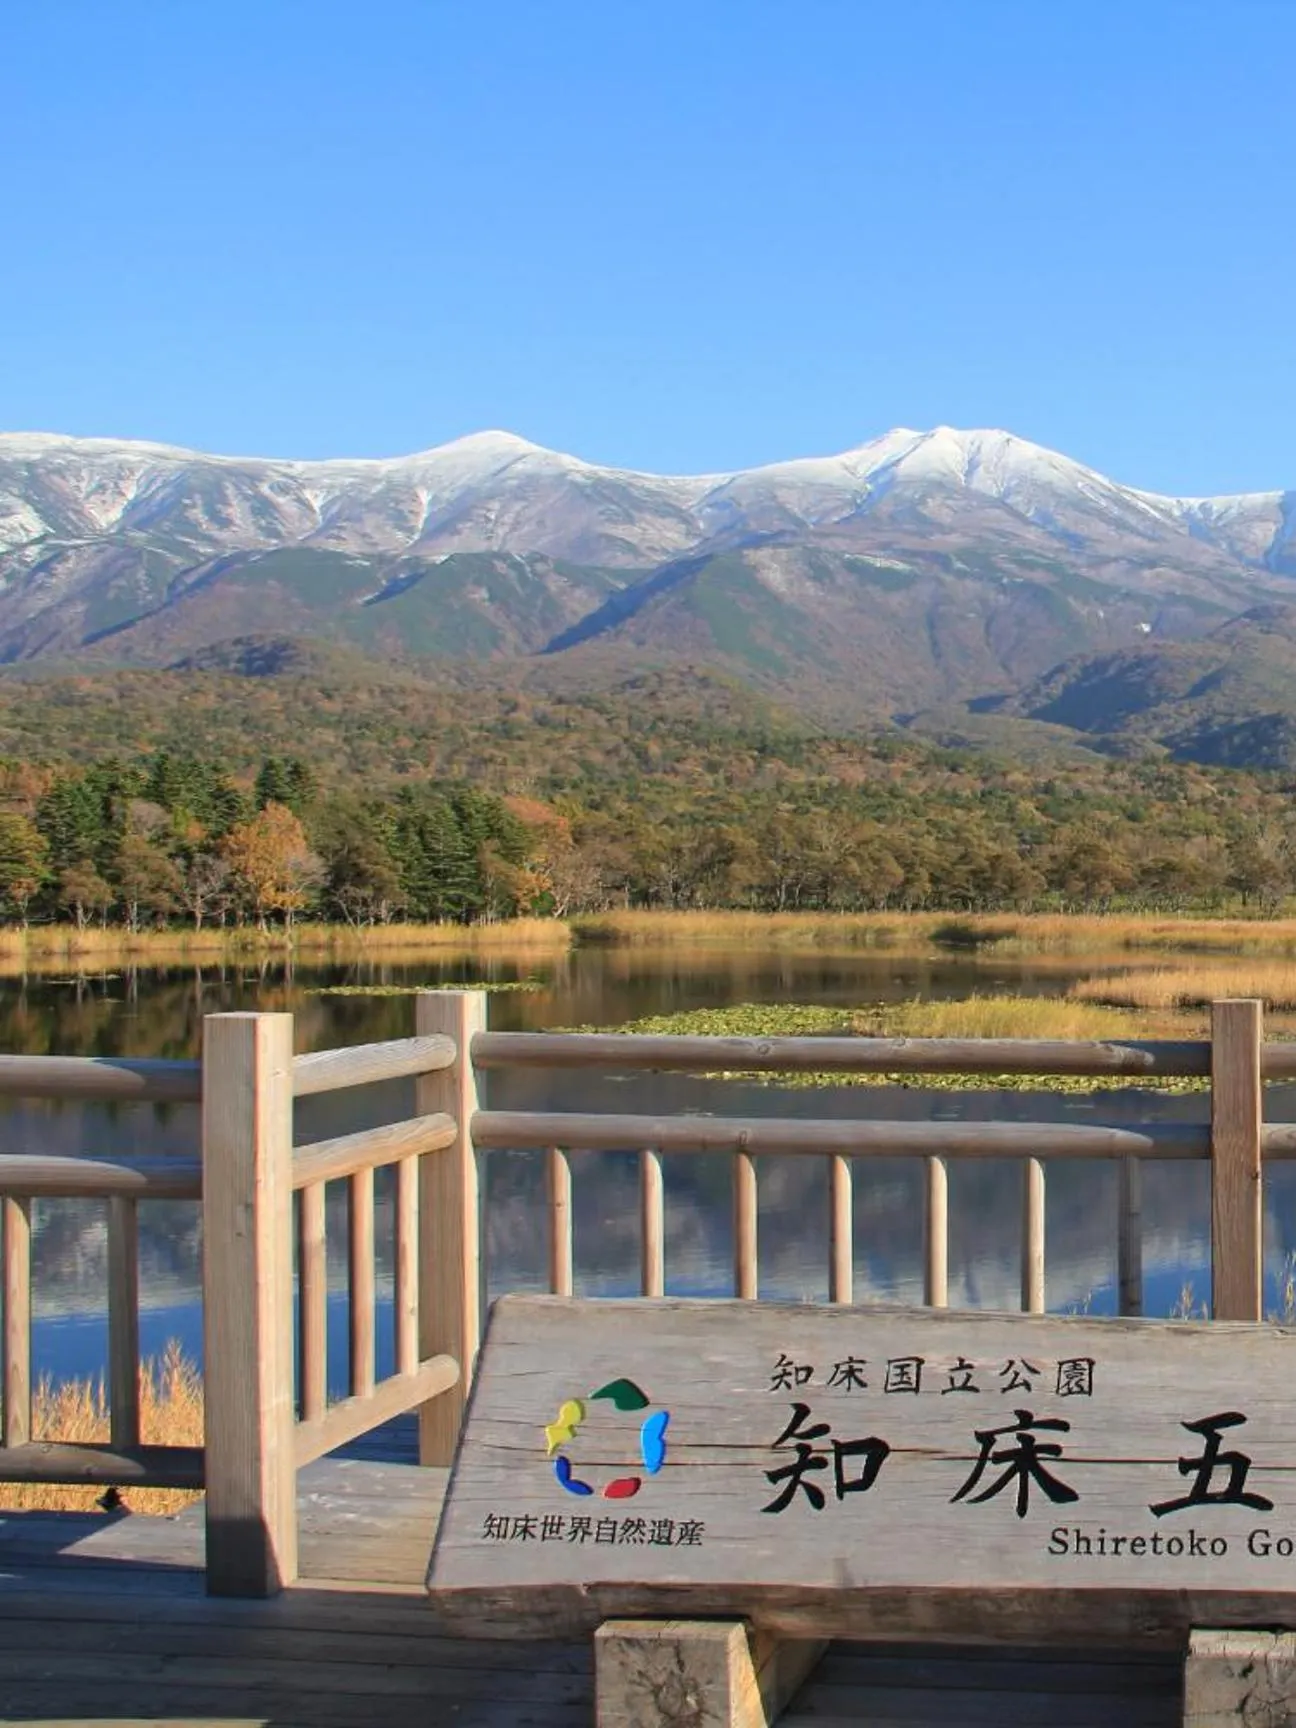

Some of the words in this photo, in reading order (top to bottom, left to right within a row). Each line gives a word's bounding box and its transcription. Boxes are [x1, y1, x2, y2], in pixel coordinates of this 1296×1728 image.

[769, 1354, 1096, 1397] 知床国立公園
[482, 1513, 705, 1546] 知床世界自然遺産
[1047, 1527, 1228, 1557] Shiretoko
